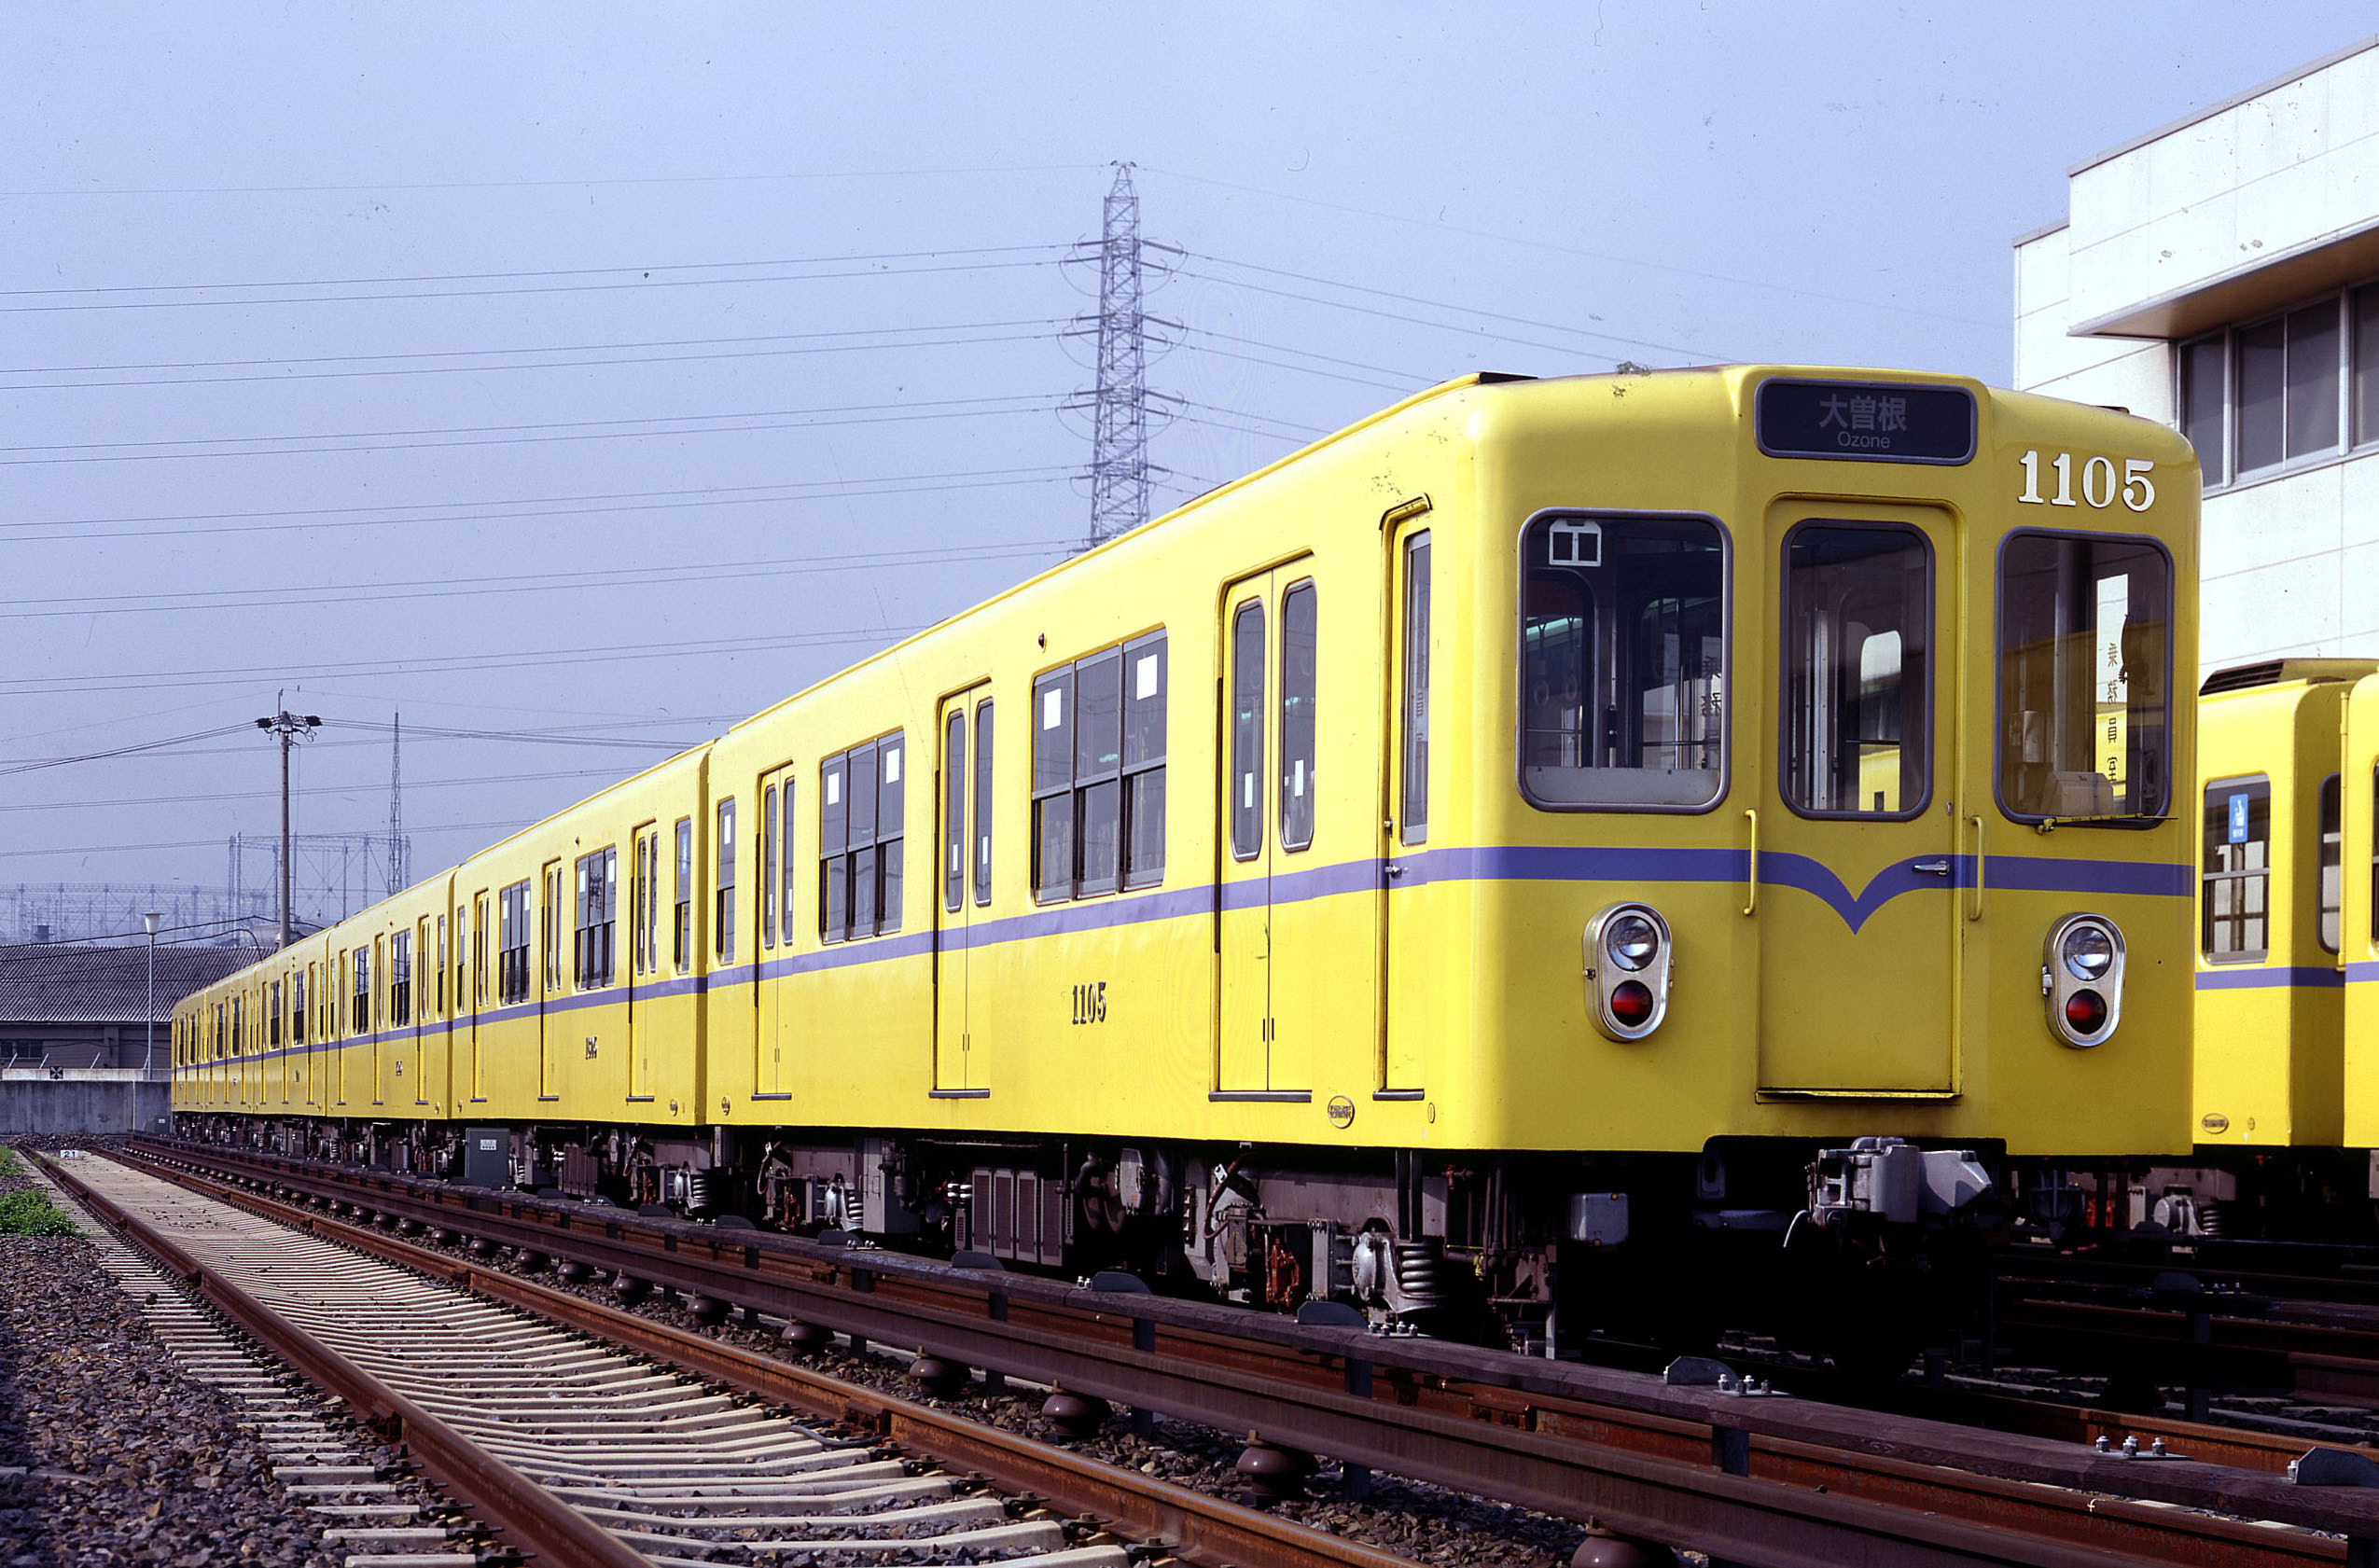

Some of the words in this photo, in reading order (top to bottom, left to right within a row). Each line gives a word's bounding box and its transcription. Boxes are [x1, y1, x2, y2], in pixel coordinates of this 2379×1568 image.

[1818, 394, 1908, 433] 大曽根
[1837, 431, 1891, 450] Ozone
[2018, 450, 2156, 513] 1105
[1072, 981, 1106, 1025] 1105
